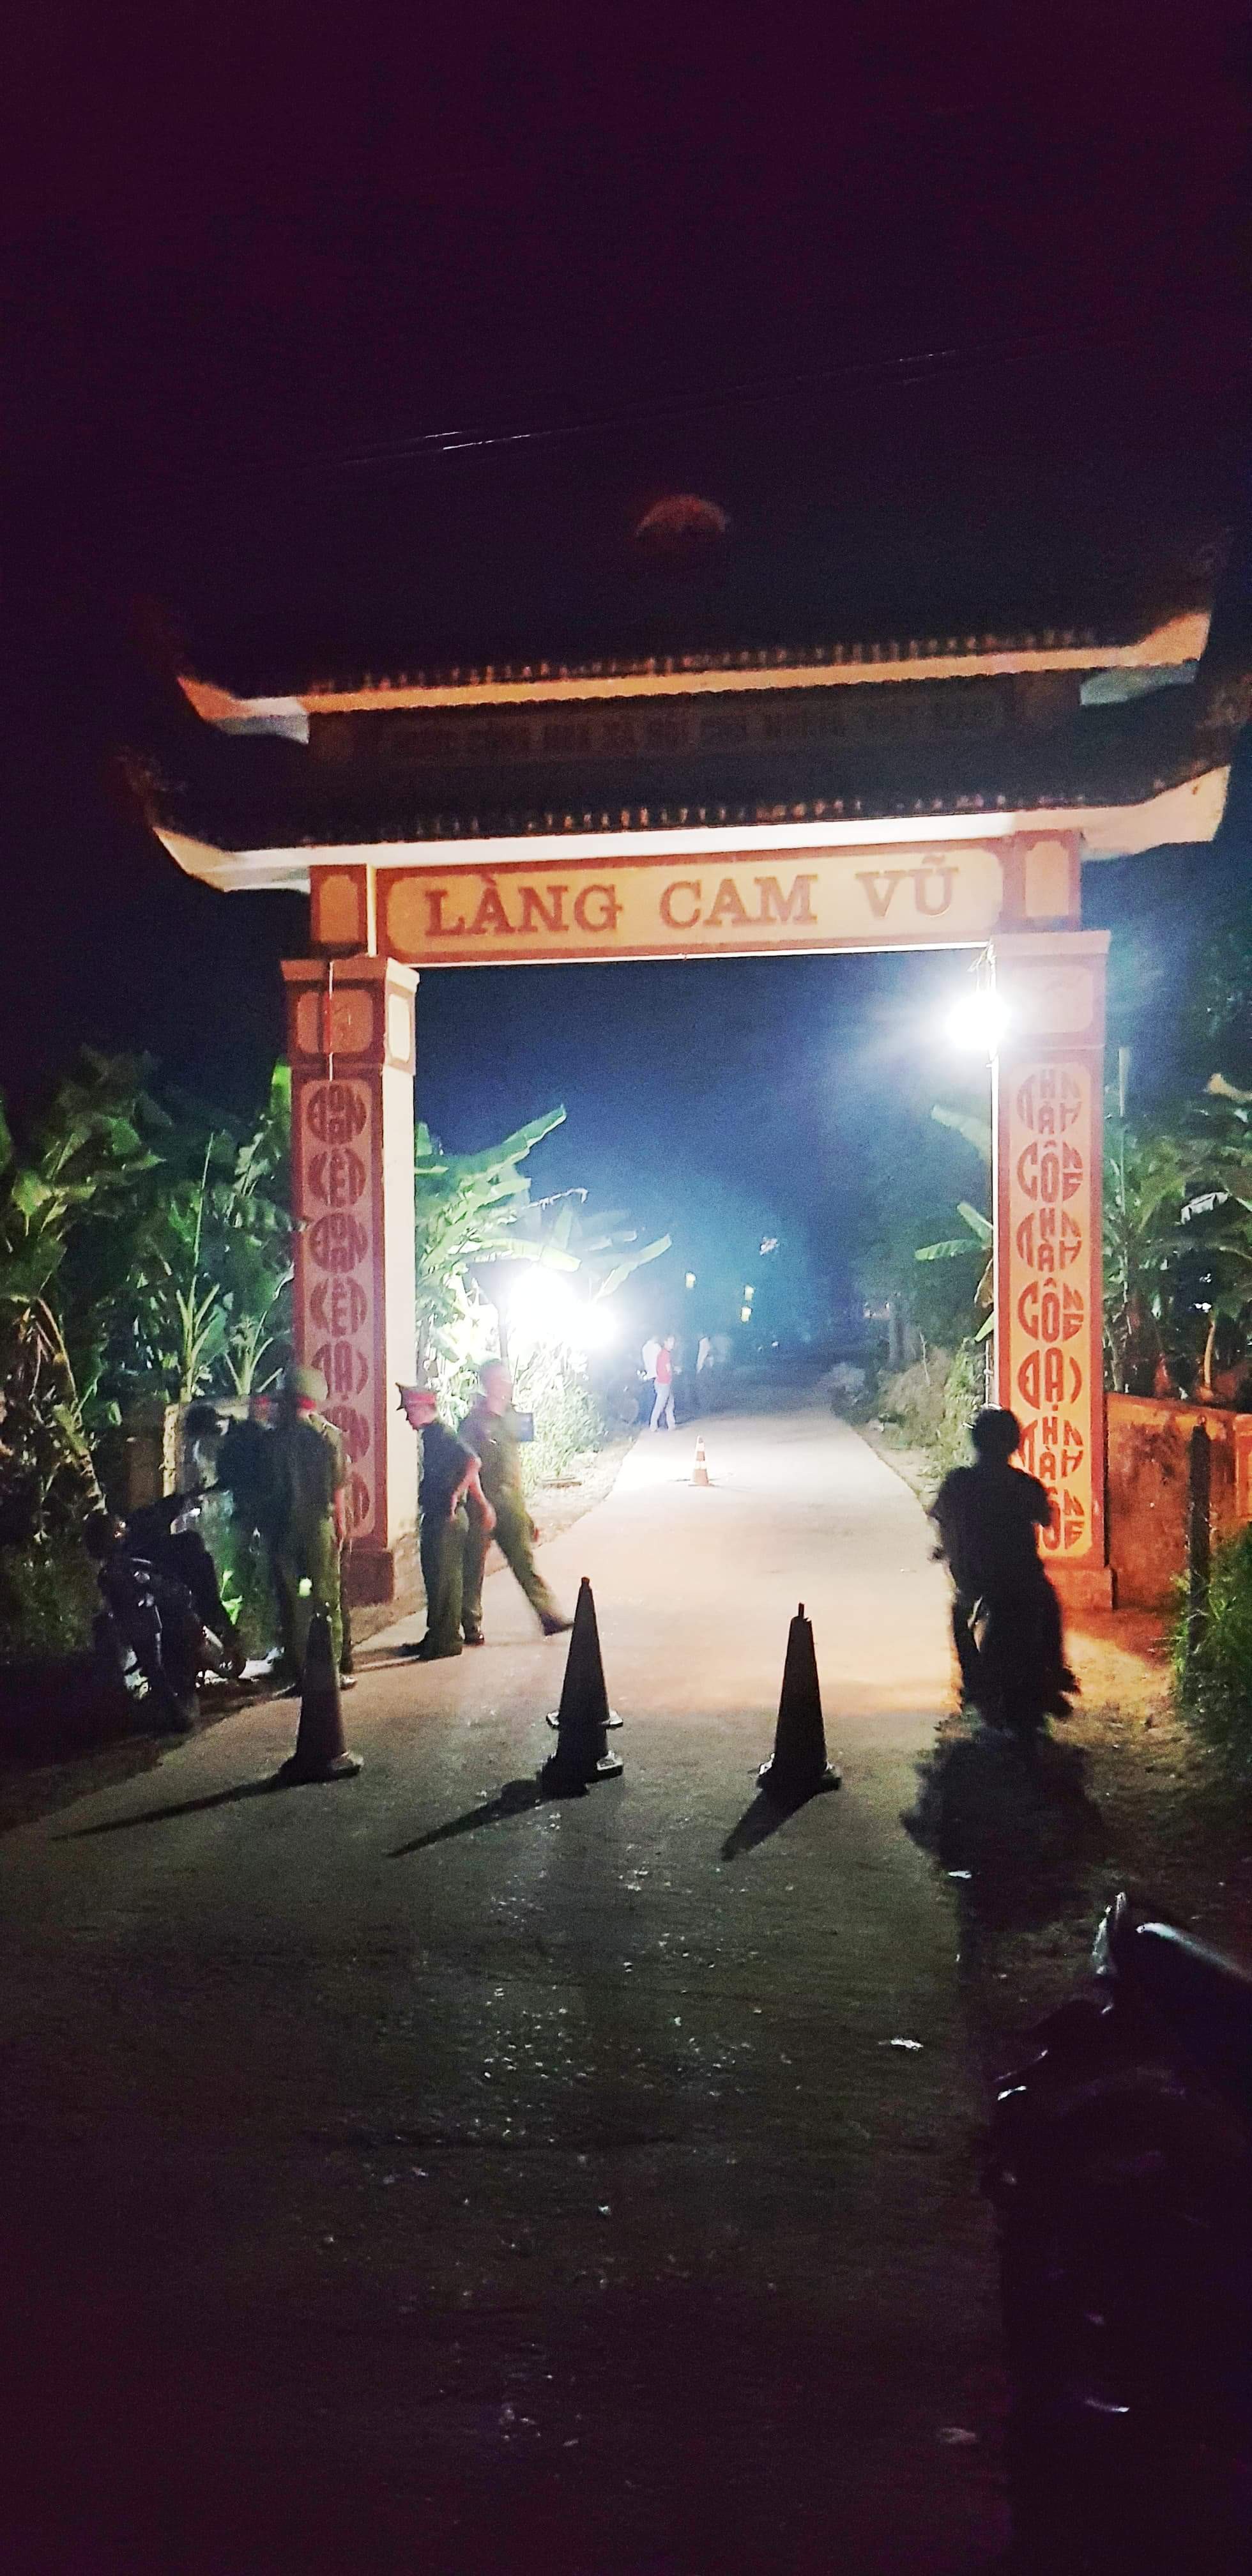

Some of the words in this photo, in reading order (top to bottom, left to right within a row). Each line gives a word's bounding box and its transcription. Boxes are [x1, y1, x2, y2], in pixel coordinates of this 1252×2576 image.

[424, 873, 623, 938] LÀNG
[659, 873, 820, 931] CAM
[856, 854, 959, 919] VŨ
[1017, 1069, 1082, 1135] THÀNH
[1017, 1140, 1083, 1202] CÔNG
[1016, 1208, 1083, 1272] THÀNH
[1018, 1277, 1084, 1342] CÔNG
[1018, 1347, 1082, 1411] ĐẠI
[1019, 1416, 1084, 1480] THÀNH
[1033, 1487, 1085, 1551] ÔNG
